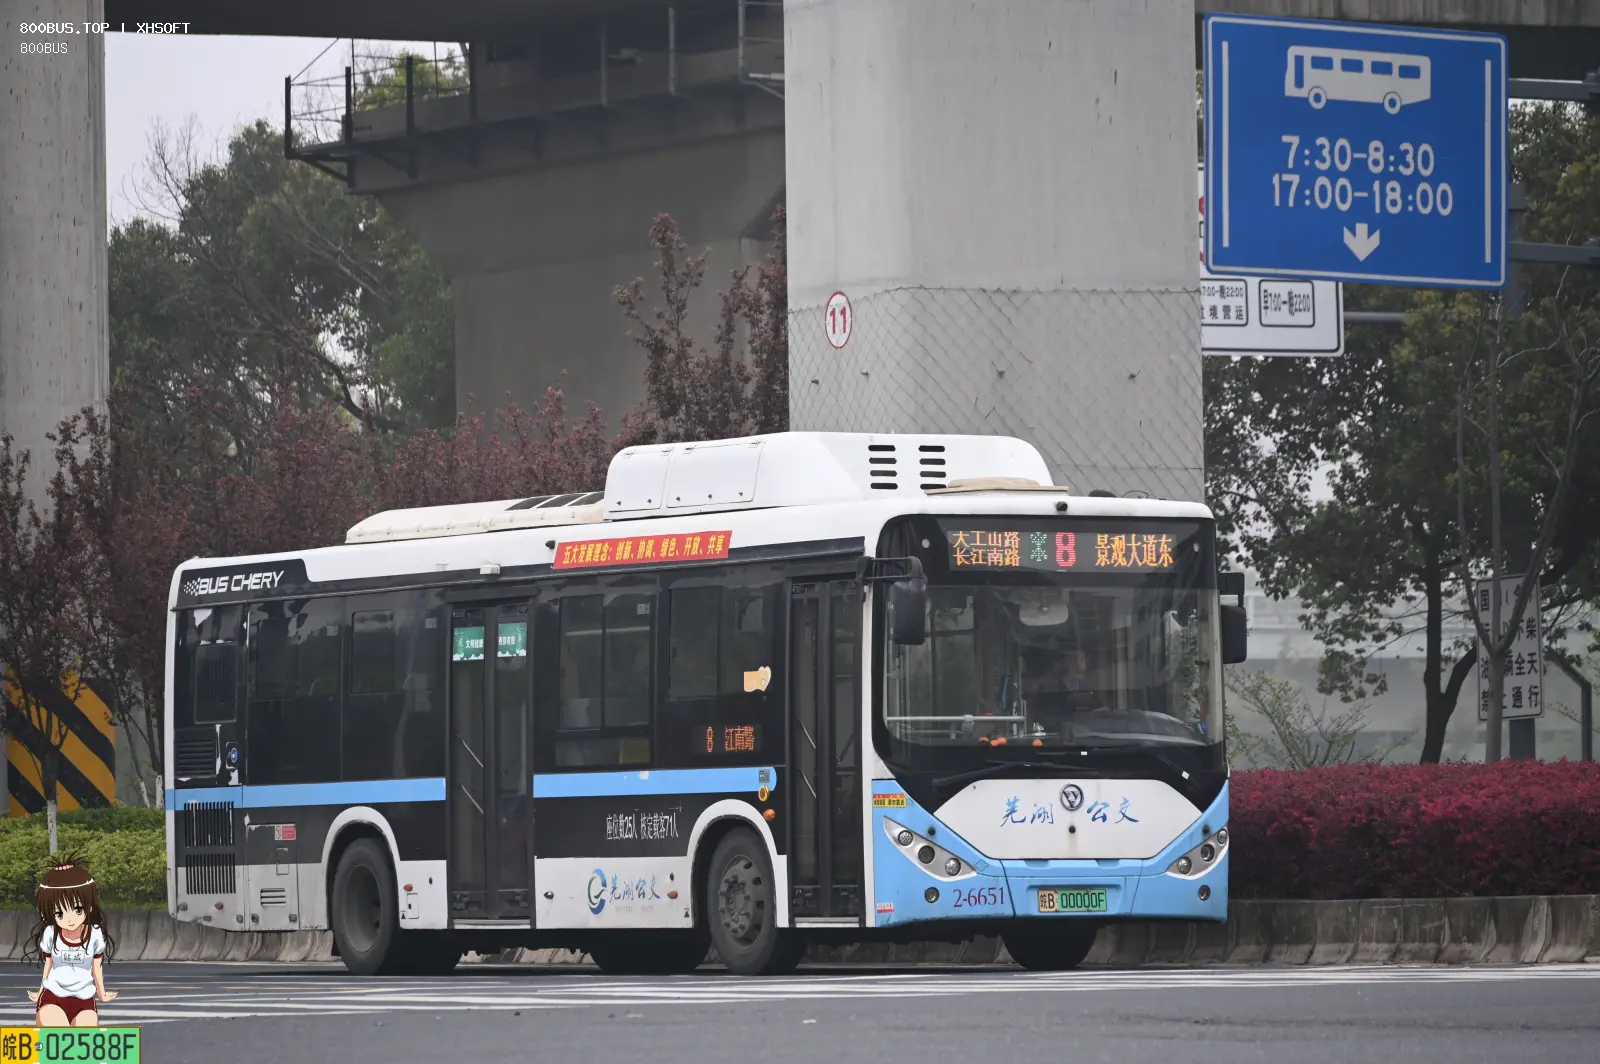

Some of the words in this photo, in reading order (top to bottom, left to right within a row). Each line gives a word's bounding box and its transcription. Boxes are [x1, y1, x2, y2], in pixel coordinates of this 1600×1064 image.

[1281, 135, 1435, 177] 7:30-8:30
[1272, 173, 1454, 217] 17:00-18:00
[1201, 284, 1244, 299] 7:00-晚22:00
[830, 306, 847, 334] 11
[952, 531, 1021, 548] 大工山路
[1055, 532, 1076, 567] 8
[1095, 533, 1175, 568] 景观大道东
[952, 547, 1021, 567] 长江南路
[198, 575, 230, 595] BUS
[231, 570, 285, 592] CHERY
[706, 726, 714, 753] 8
[1000, 796, 1055, 828] 芜湖
[1086, 796, 1141, 826] 公交
[953, 887, 1005, 908] 2-6651
